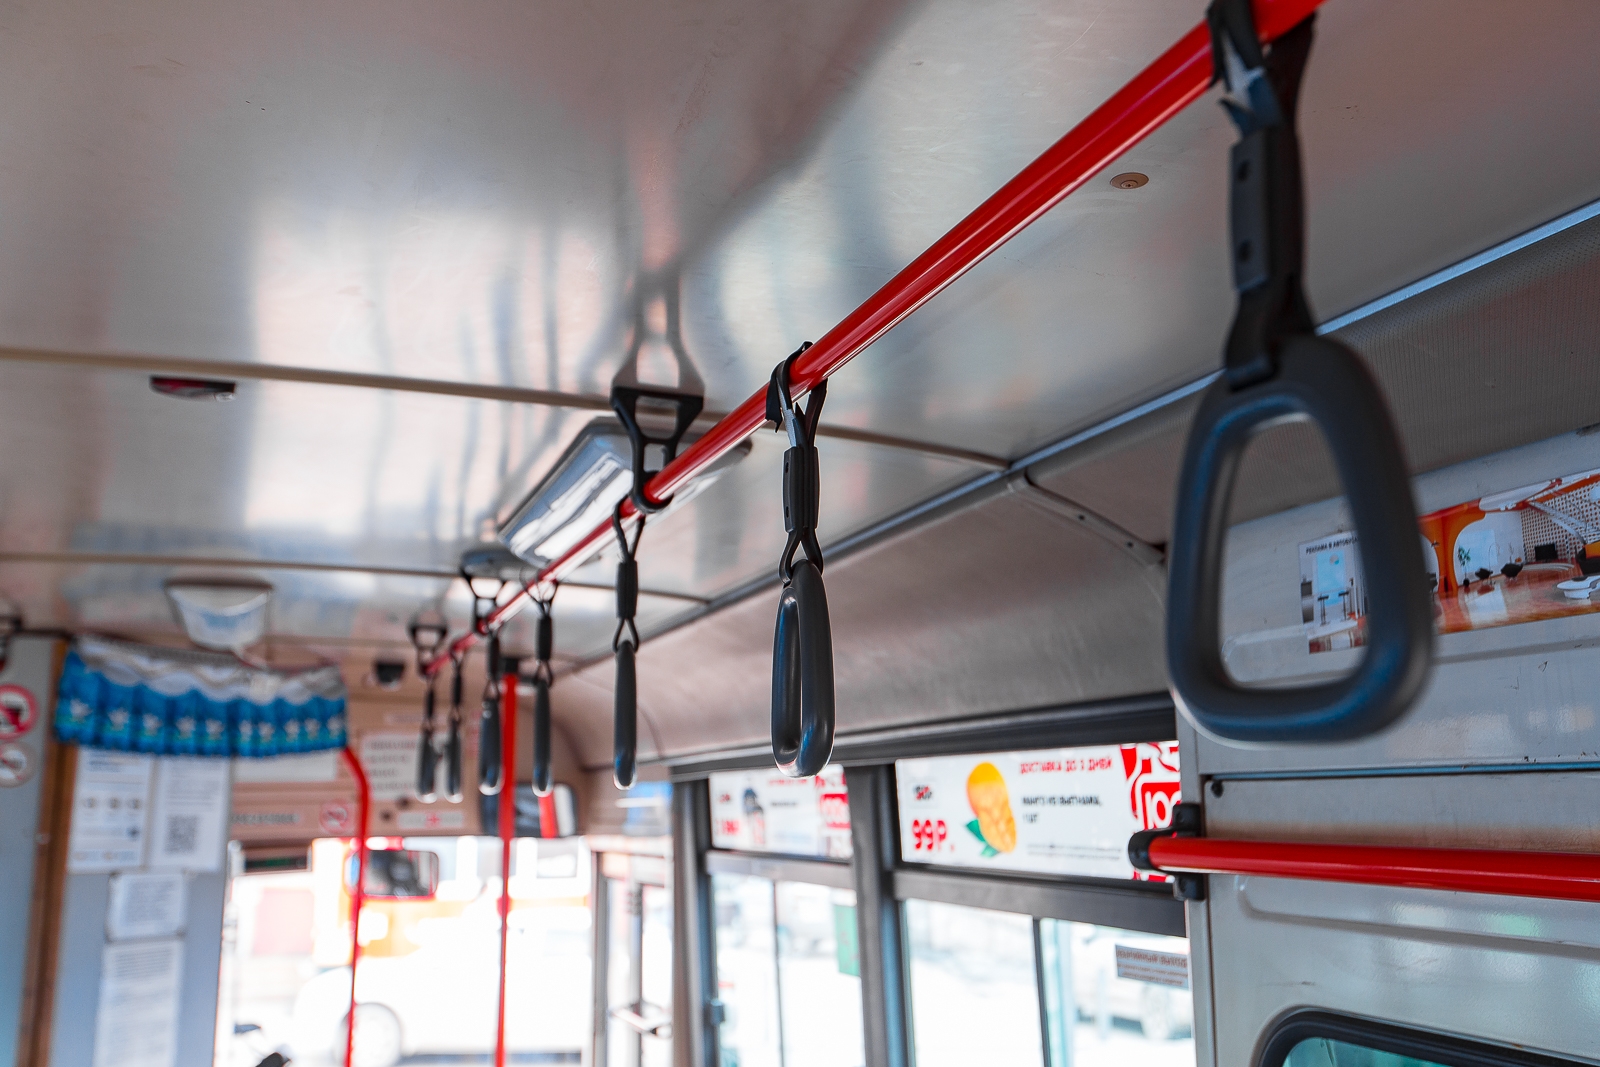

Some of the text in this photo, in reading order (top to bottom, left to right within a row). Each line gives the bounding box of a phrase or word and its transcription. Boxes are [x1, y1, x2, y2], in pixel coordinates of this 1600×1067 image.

[1305, 543, 1328, 555] РЕКЛАМА
[1020, 761, 1062, 774] ДОСТАВКА
[1065, 759, 1077, 772] ДО
[1088, 757, 1112, 771] ДНЕЙ
